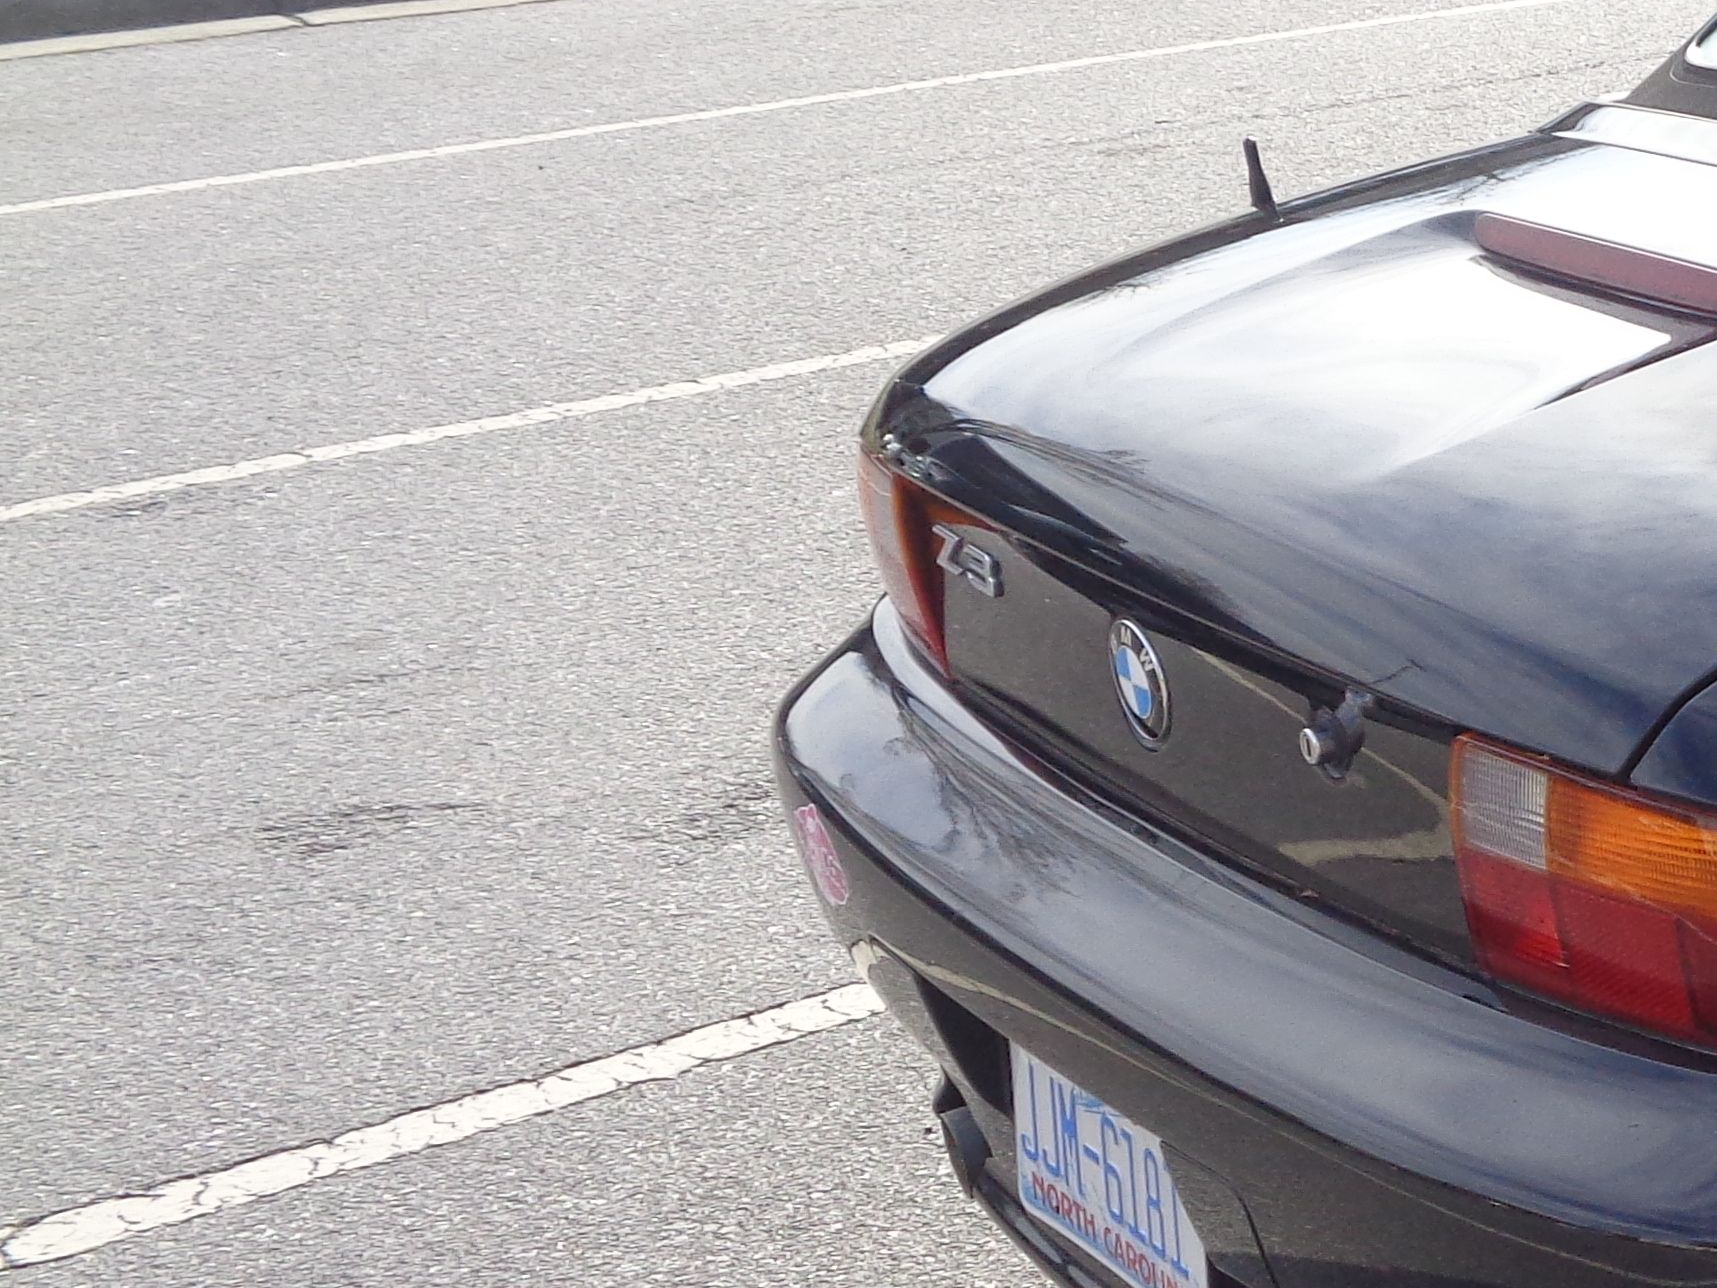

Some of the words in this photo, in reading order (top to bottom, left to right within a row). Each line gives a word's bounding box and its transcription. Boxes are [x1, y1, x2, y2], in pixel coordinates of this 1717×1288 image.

[932, 523, 1004, 599] Z3
[1020, 1059, 1190, 1280] JJM-6181
[1031, 1169, 1098, 1243] NORTH
